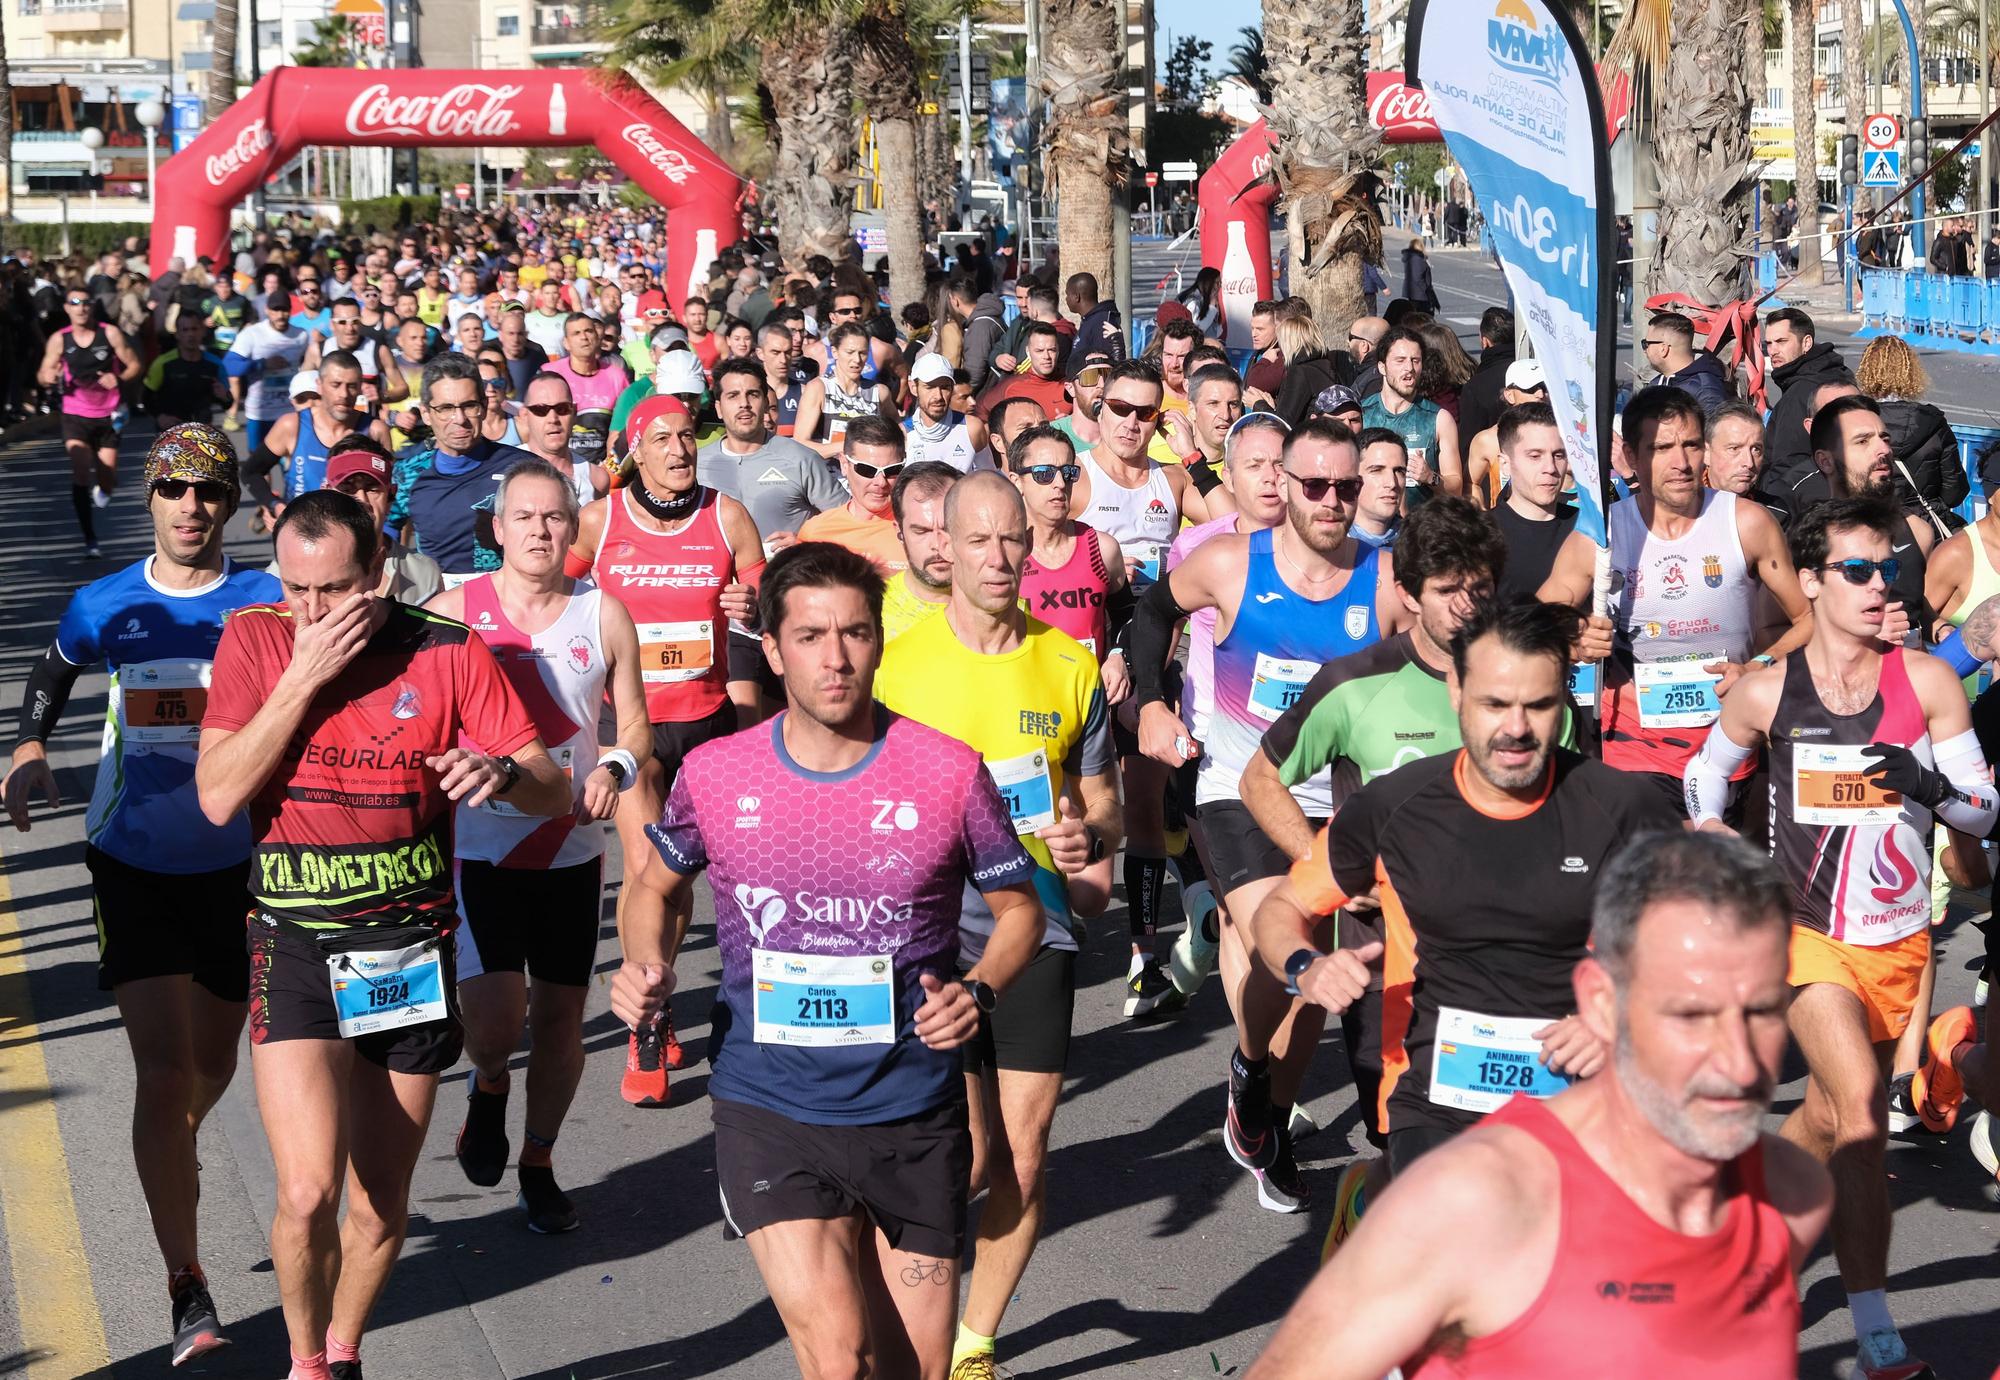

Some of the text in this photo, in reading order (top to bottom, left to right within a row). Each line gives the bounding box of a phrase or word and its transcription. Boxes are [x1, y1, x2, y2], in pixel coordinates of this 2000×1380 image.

[346, 83, 523, 137] Coca-Cola
[1871, 125, 1892, 138] 30
[621, 123, 698, 186] Coca-Cola
[608, 564, 716, 577] RUNNER
[621, 576, 722, 590] VARESE
[1667, 618, 1709, 629] Gruas
[1669, 624, 1720, 636] arronis
[117, 631, 150, 640] VIATOR
[661, 650, 683, 665] 671
[1665, 690, 1705, 709] 2358
[155, 700, 187, 719] 475
[1019, 710, 1050, 725] FREE
[1019, 723, 1058, 739] LETICS
[1835, 773, 1863, 781] PERALTA
[1833, 783, 1865, 801] 670
[799, 932, 857, 951] Bienestar
[367, 981, 409, 1008] 1924
[808, 987, 837, 996] Carlos
[797, 997, 849, 1020] 2113
[1486, 1051, 1530, 1063] ANIMAME!
[1478, 1062, 1534, 1087] 1528
[1468, 1084, 1494, 1094] PASCUAL
